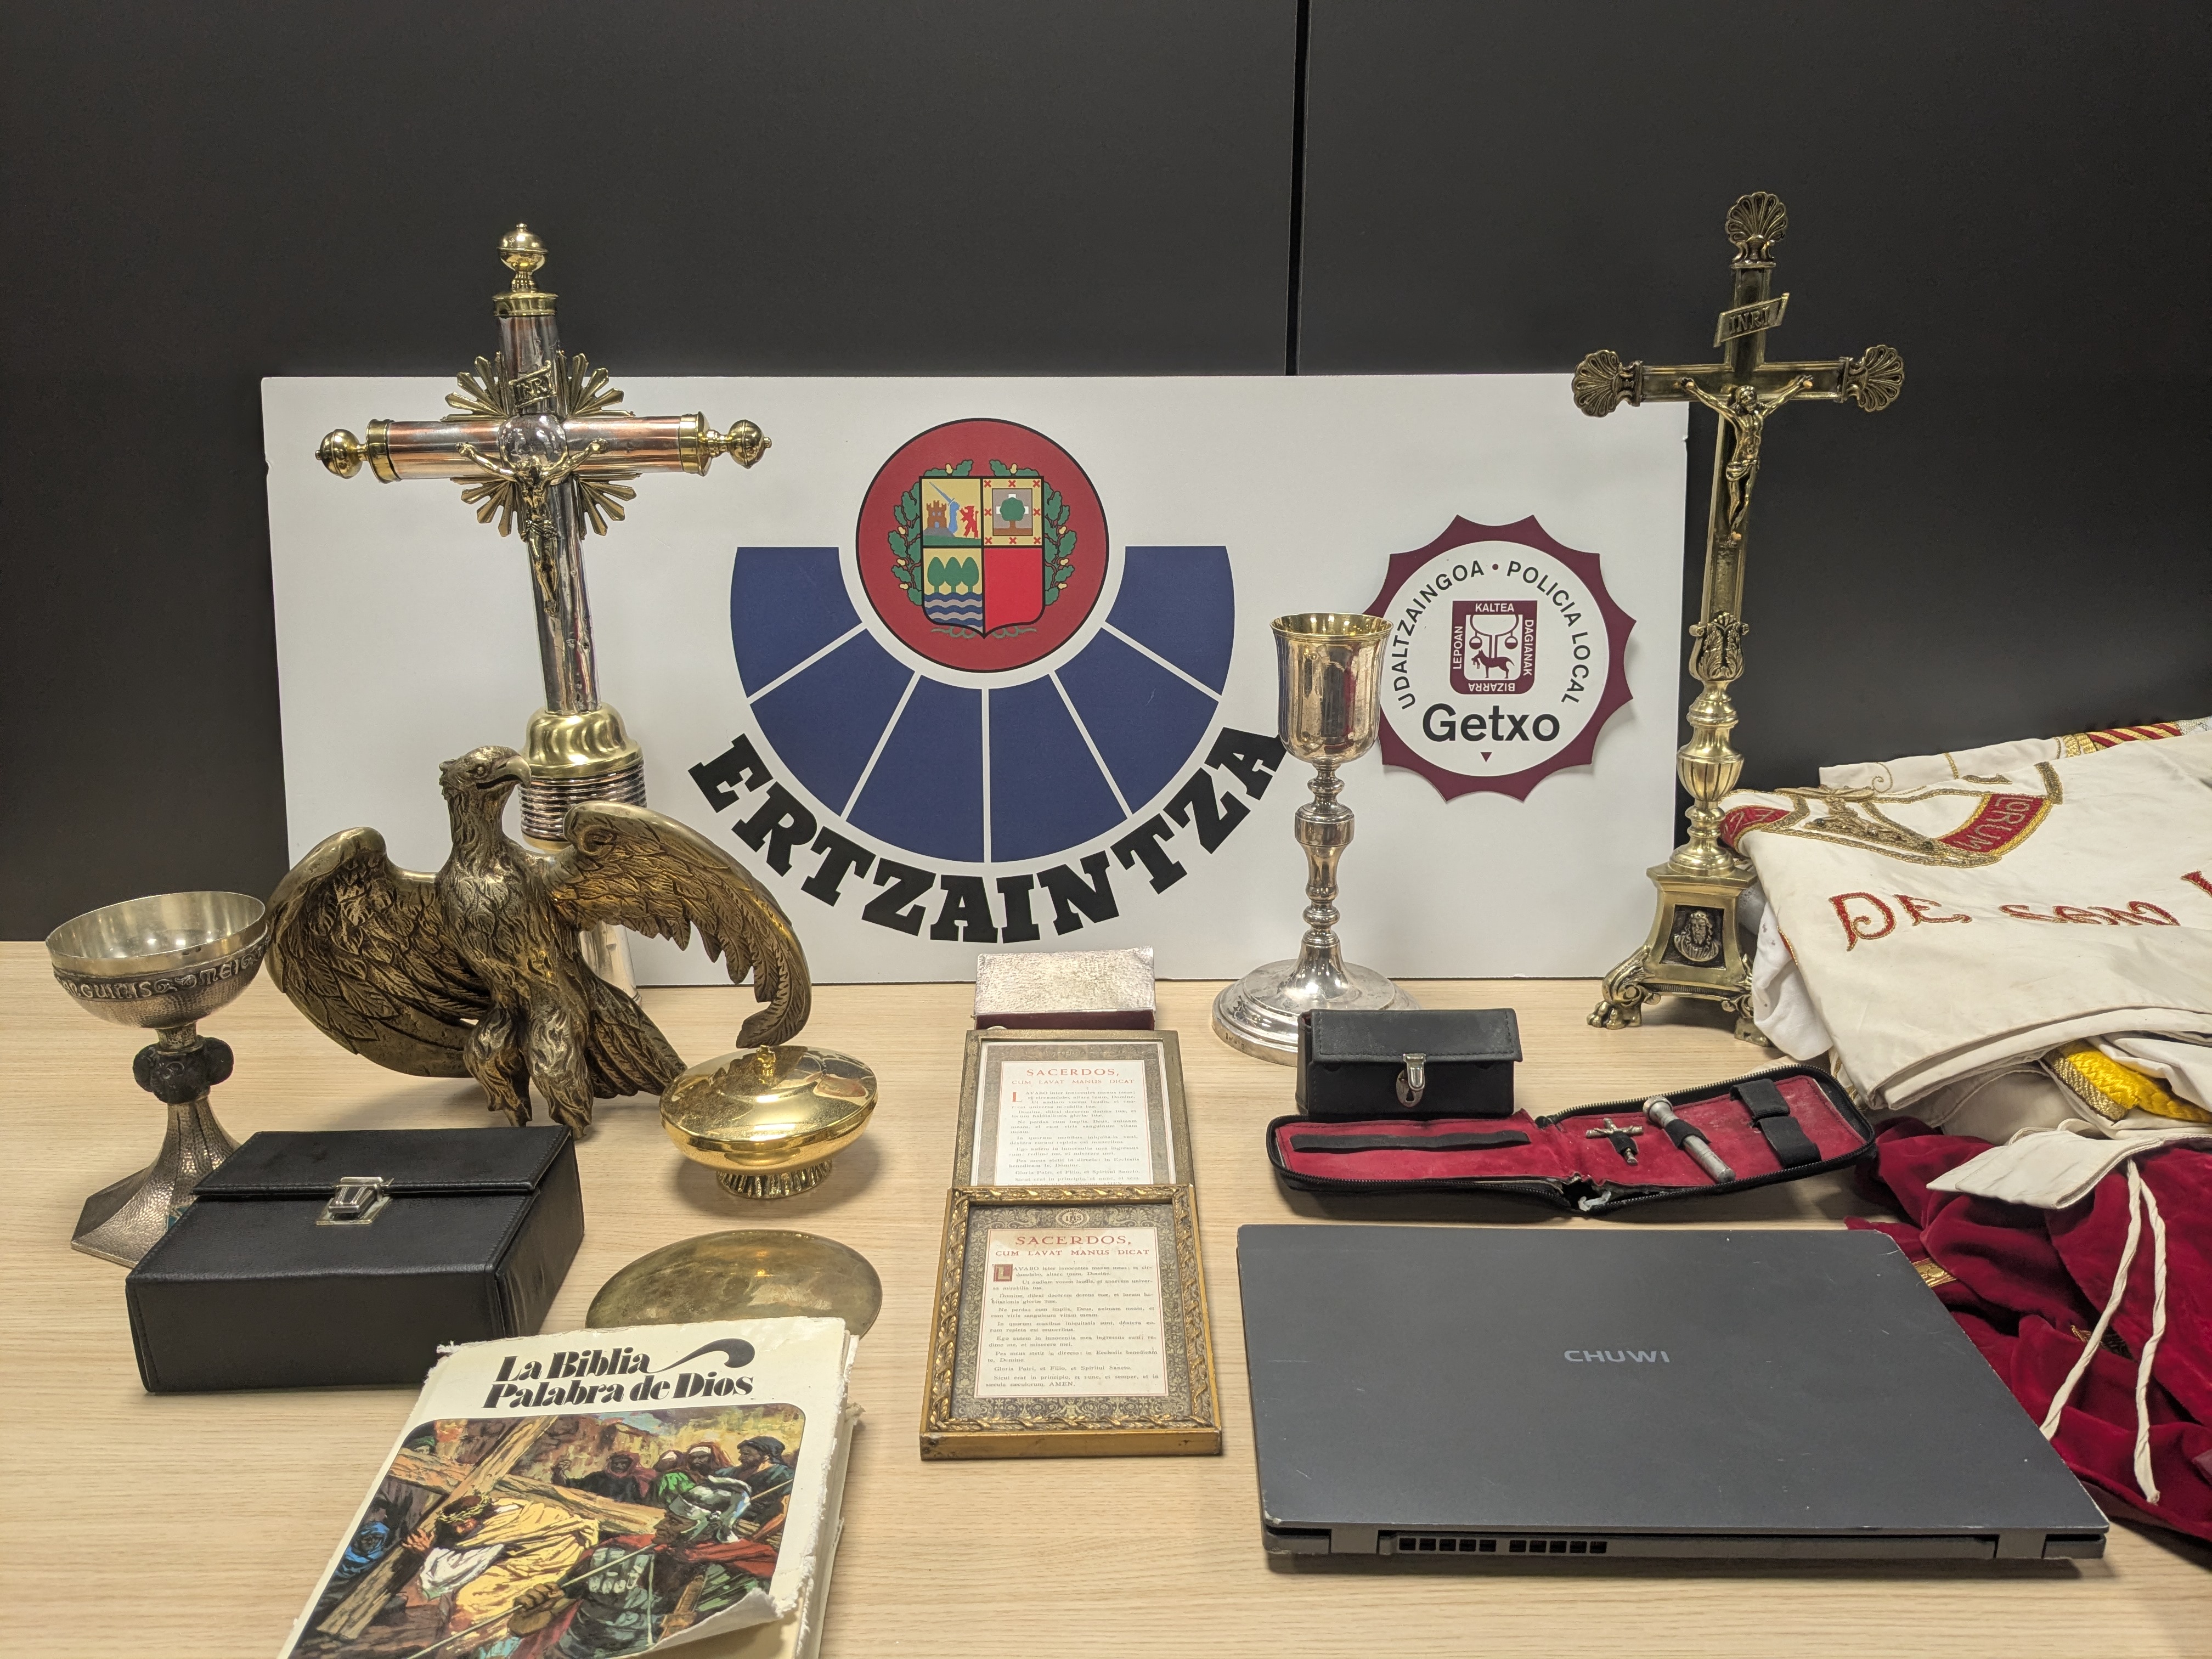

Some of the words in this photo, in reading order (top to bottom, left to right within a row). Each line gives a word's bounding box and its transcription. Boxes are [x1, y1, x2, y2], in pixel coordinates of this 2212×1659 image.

[1729, 306, 1771, 334] INRI
[1475, 603, 1515, 613] KALTEA
[1391, 560, 1485, 710] UDALTZAINGOA
[1506, 560, 1582, 628] POLICIA
[1560, 631, 1591, 704] LOCAL
[1453, 625, 1464, 670] LEPOAN
[1522, 619, 1534, 676] DAGIANAK
[1468, 682, 1516, 692] BIZARRA
[1422, 703, 1560, 742] Getxo
[688, 727, 1288, 944] ERTZAINTZA
[1828, 891, 1973, 952] DE
[57, 977, 151, 1000] ANGUINIS
[1015, 1235, 1131, 1245] SACERDOS,
[494, 1355, 543, 1383] La
[1564, 1350, 1671, 1363] CHUWI
[482, 1380, 624, 1409] Palabra
[629, 1375, 672, 1402] de
[670, 1372, 754, 1399] Dios
